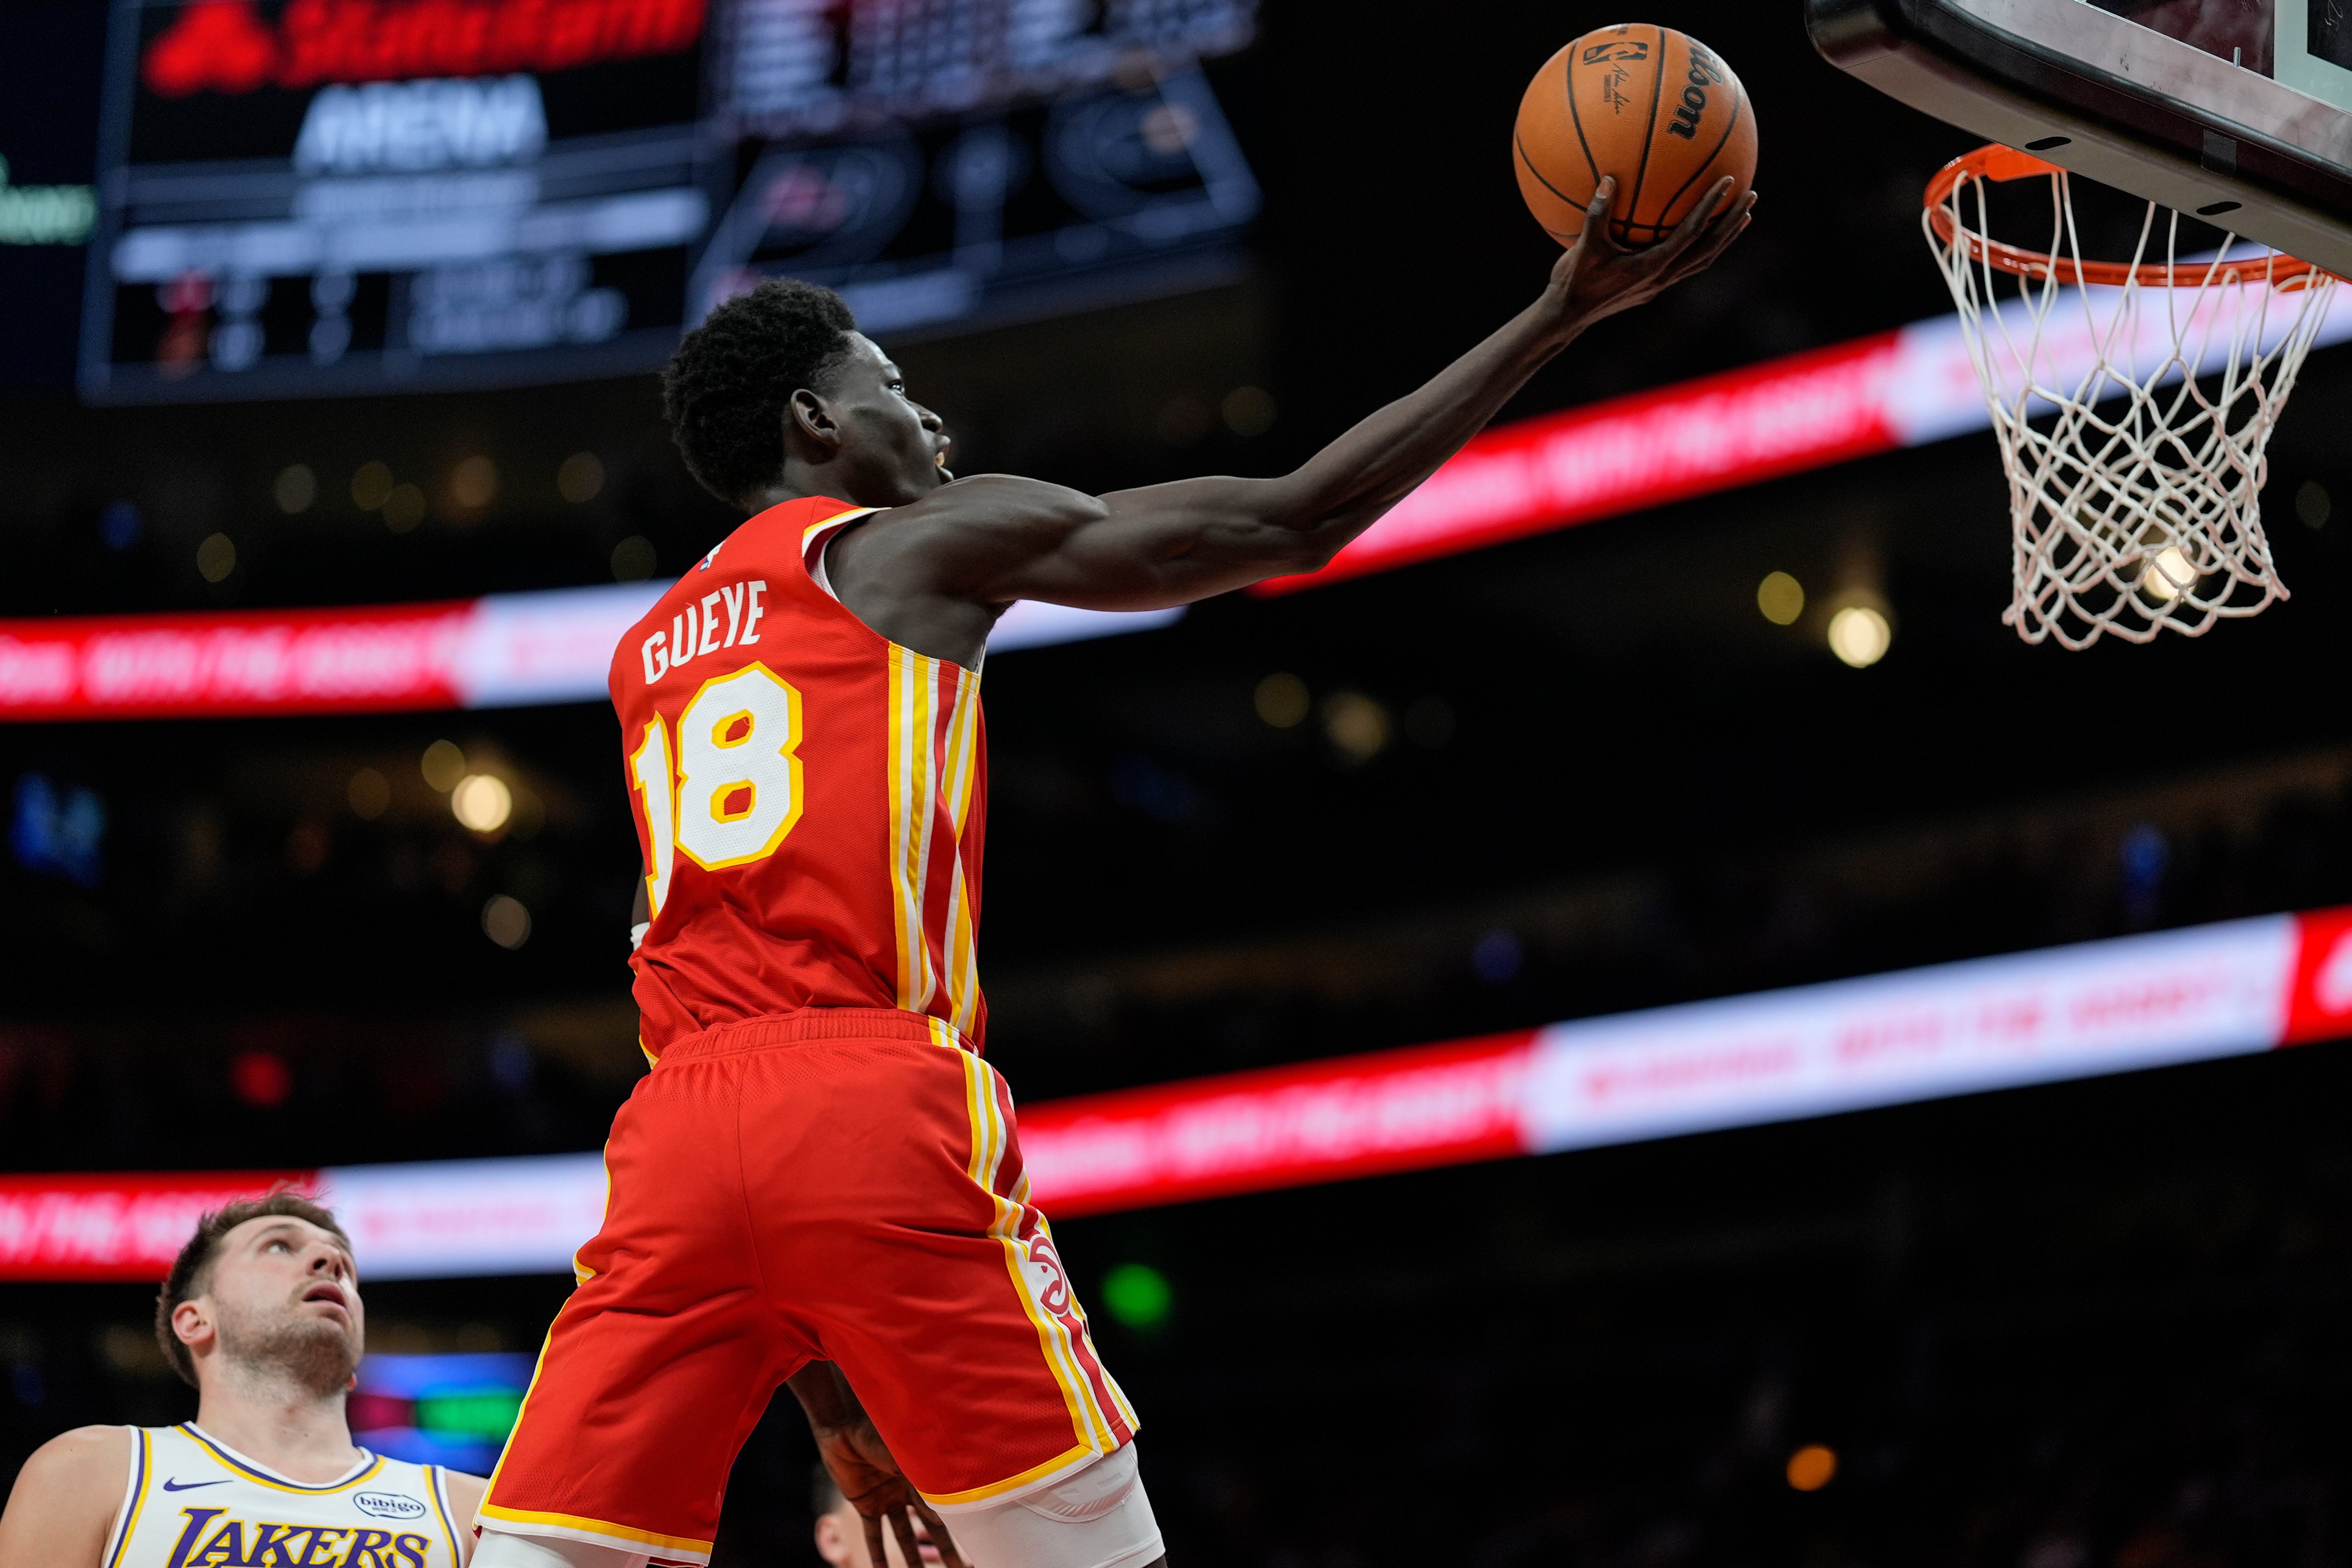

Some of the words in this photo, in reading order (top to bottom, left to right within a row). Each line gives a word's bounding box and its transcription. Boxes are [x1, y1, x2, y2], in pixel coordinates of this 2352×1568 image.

[1667, 36, 1724, 140] ilson
[641, 580, 767, 685] GUEYE
[629, 660, 804, 922] 18
[164, 1506, 432, 1568] LAKERS
[360, 1497, 421, 1512] bibigo
